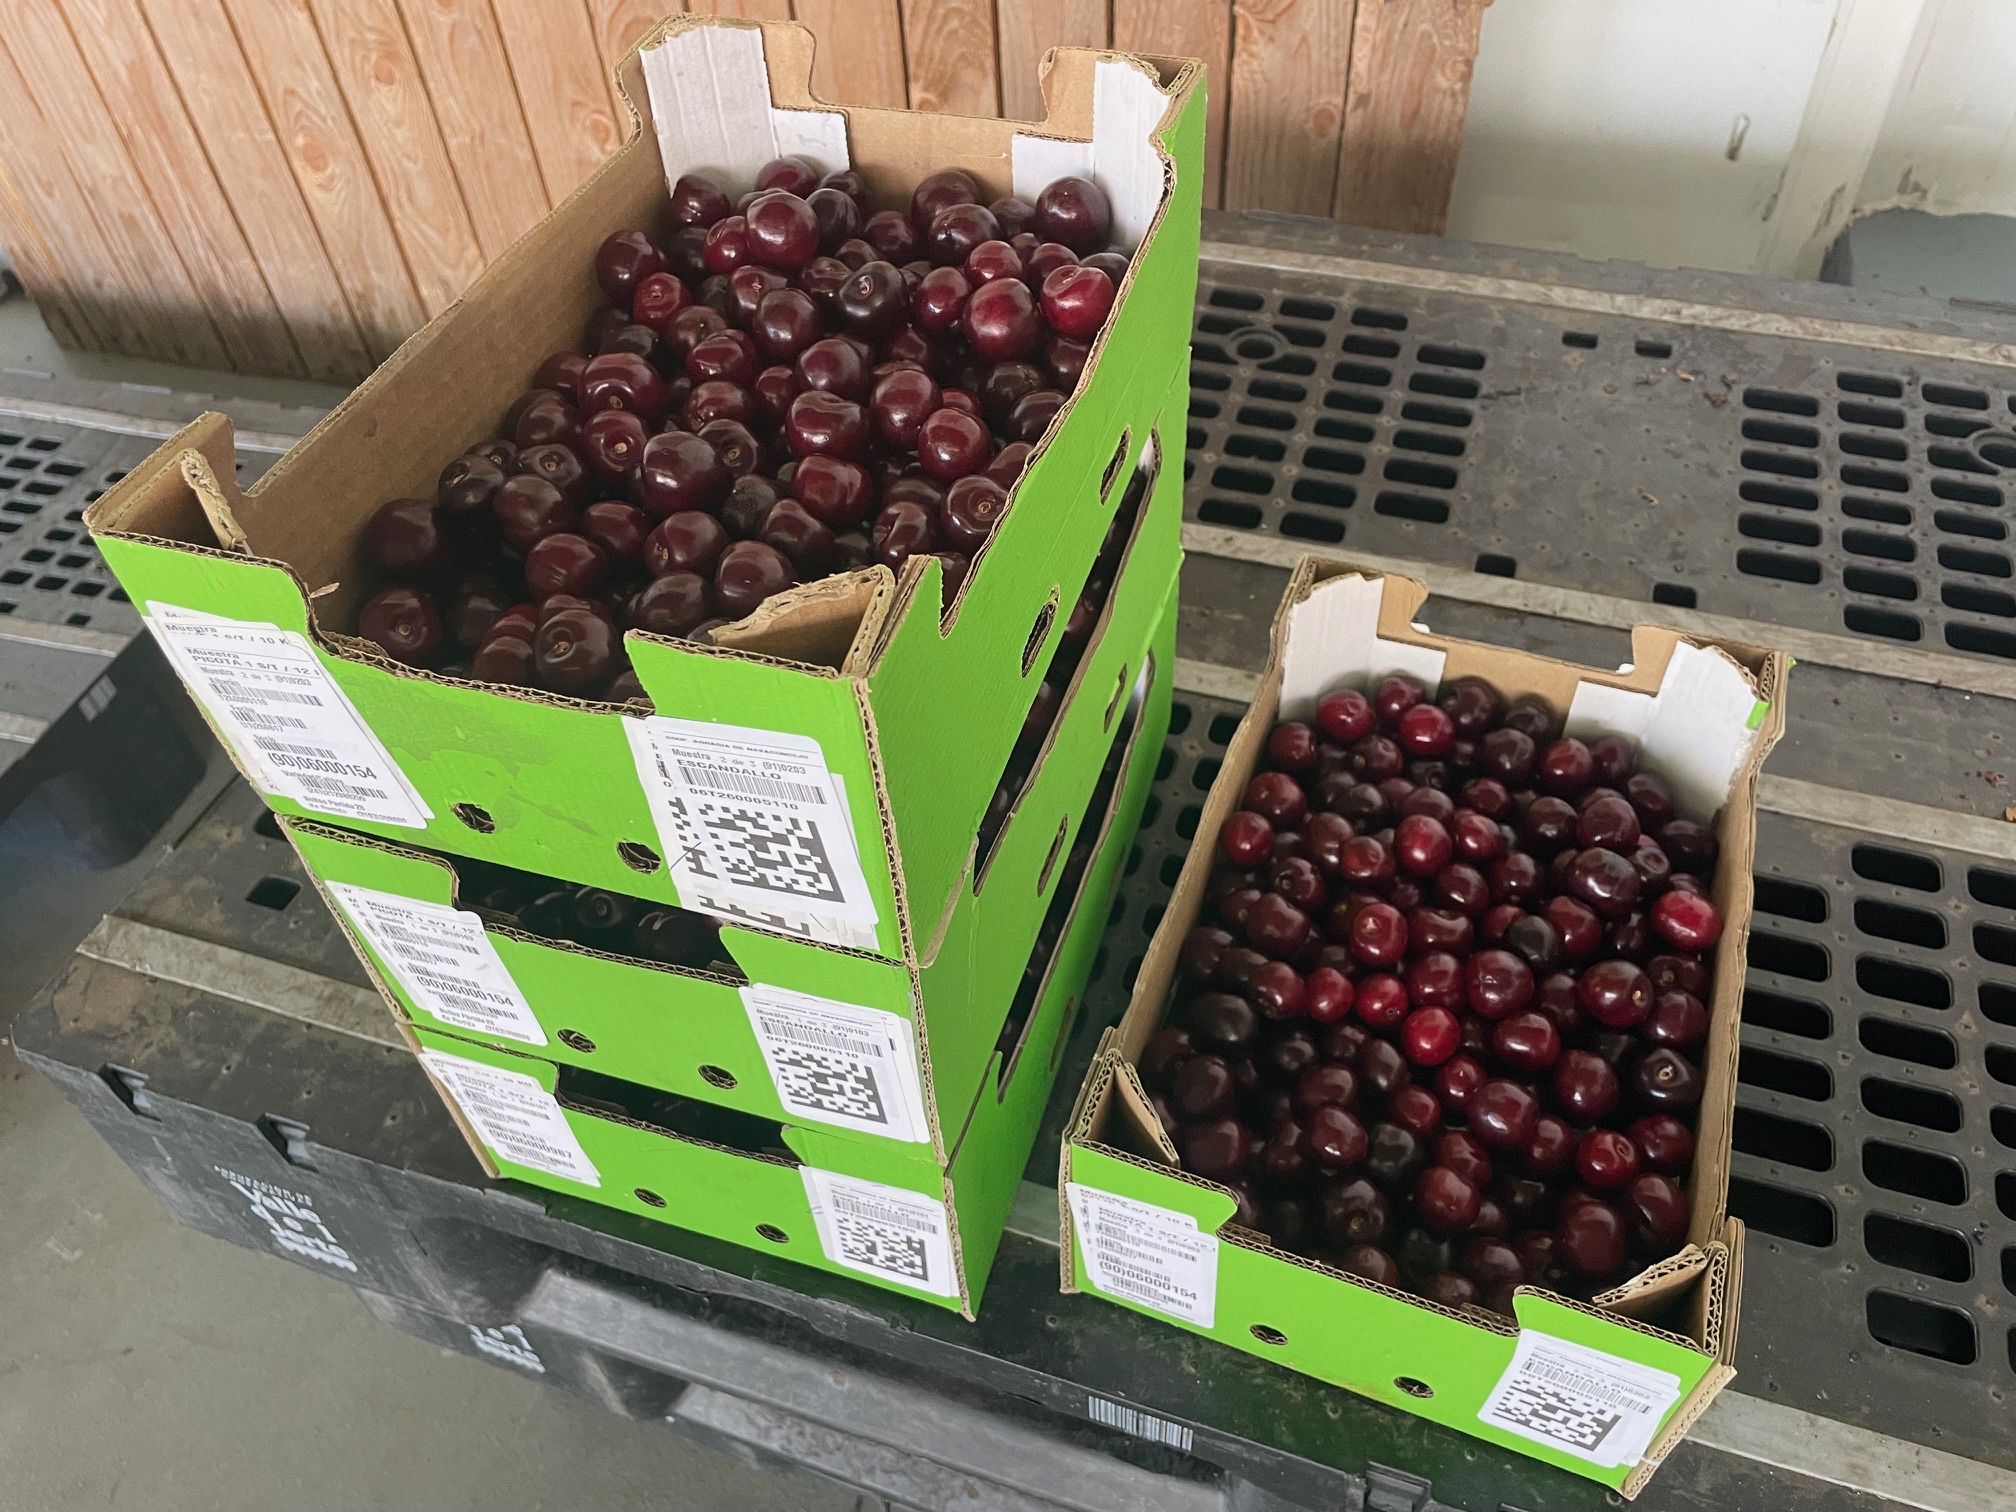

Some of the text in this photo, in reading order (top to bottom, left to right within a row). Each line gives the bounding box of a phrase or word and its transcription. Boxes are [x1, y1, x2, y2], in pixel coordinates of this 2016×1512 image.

[165, 624, 217, 634] Muestra
[187, 648, 240, 659] Muestra
[193, 655, 241, 667] PICOTA
[259, 663, 278, 672] S/T
[296, 667, 312, 675] 12
[200, 667, 235, 677] Muestra
[241, 671, 248, 679] 2
[265, 674, 271, 682] 3
[268, 752, 377, 780] (90)06000154
[672, 748, 807, 775] Muestra 2 de 3 (91)0203
[677, 759, 782, 780] ESCANDALLO
[689, 788, 799, 811] 06T260005110
[366, 900, 413, 916] Muestra
[375, 914, 404, 926] Muestra
[417, 976, 514, 1006] (90)06000154
[756, 1008, 789, 1020] Muestra
[759, 1015, 848, 1038] ESCANDALLO
[230, 1180, 321, 1224] Valle
[270, 1222, 349, 1260] Jerte
[1100, 1261, 1197, 1300] (90)06000154
[1529, 1357, 1621, 1394] ESCANDALLO
